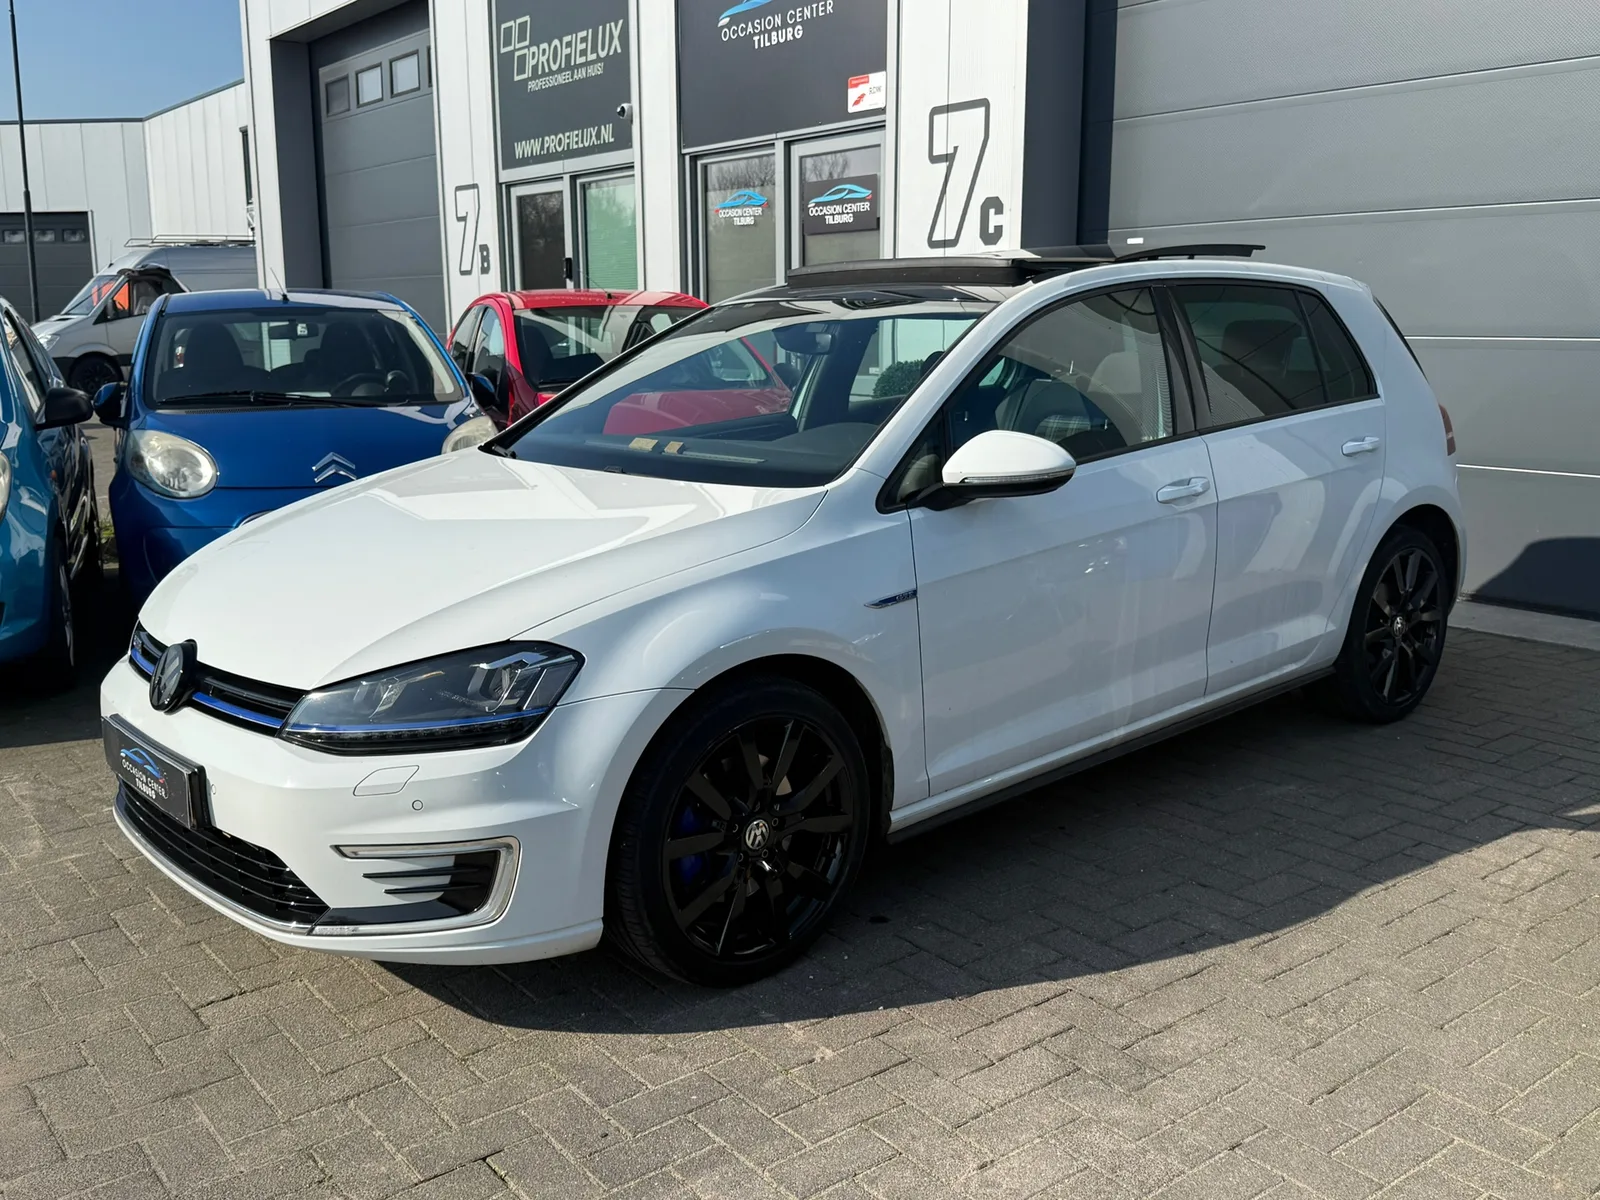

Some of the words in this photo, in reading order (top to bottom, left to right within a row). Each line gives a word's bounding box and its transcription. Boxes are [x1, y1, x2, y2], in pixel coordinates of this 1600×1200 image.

[721, 13, 782, 42] OCCASION
[786, 0, 834, 24] CENTER
[528, 19, 624, 78] PROFIELUX
[753, 25, 804, 49] TILBURG
[527, 71, 573, 93] PROFESSIONEEL
[573, 66, 587, 81] AAN
[514, 123, 615, 160] WWW.PROFIELUX.NL
[718, 208, 743, 218] OCCASION
[743, 207, 763, 216] CENTER
[733, 216, 755, 226] TILBURG
[808, 204, 843, 217] OCCASION
[842, 202, 871, 213] CENTER
[824, 213, 854, 225] TILBURG
